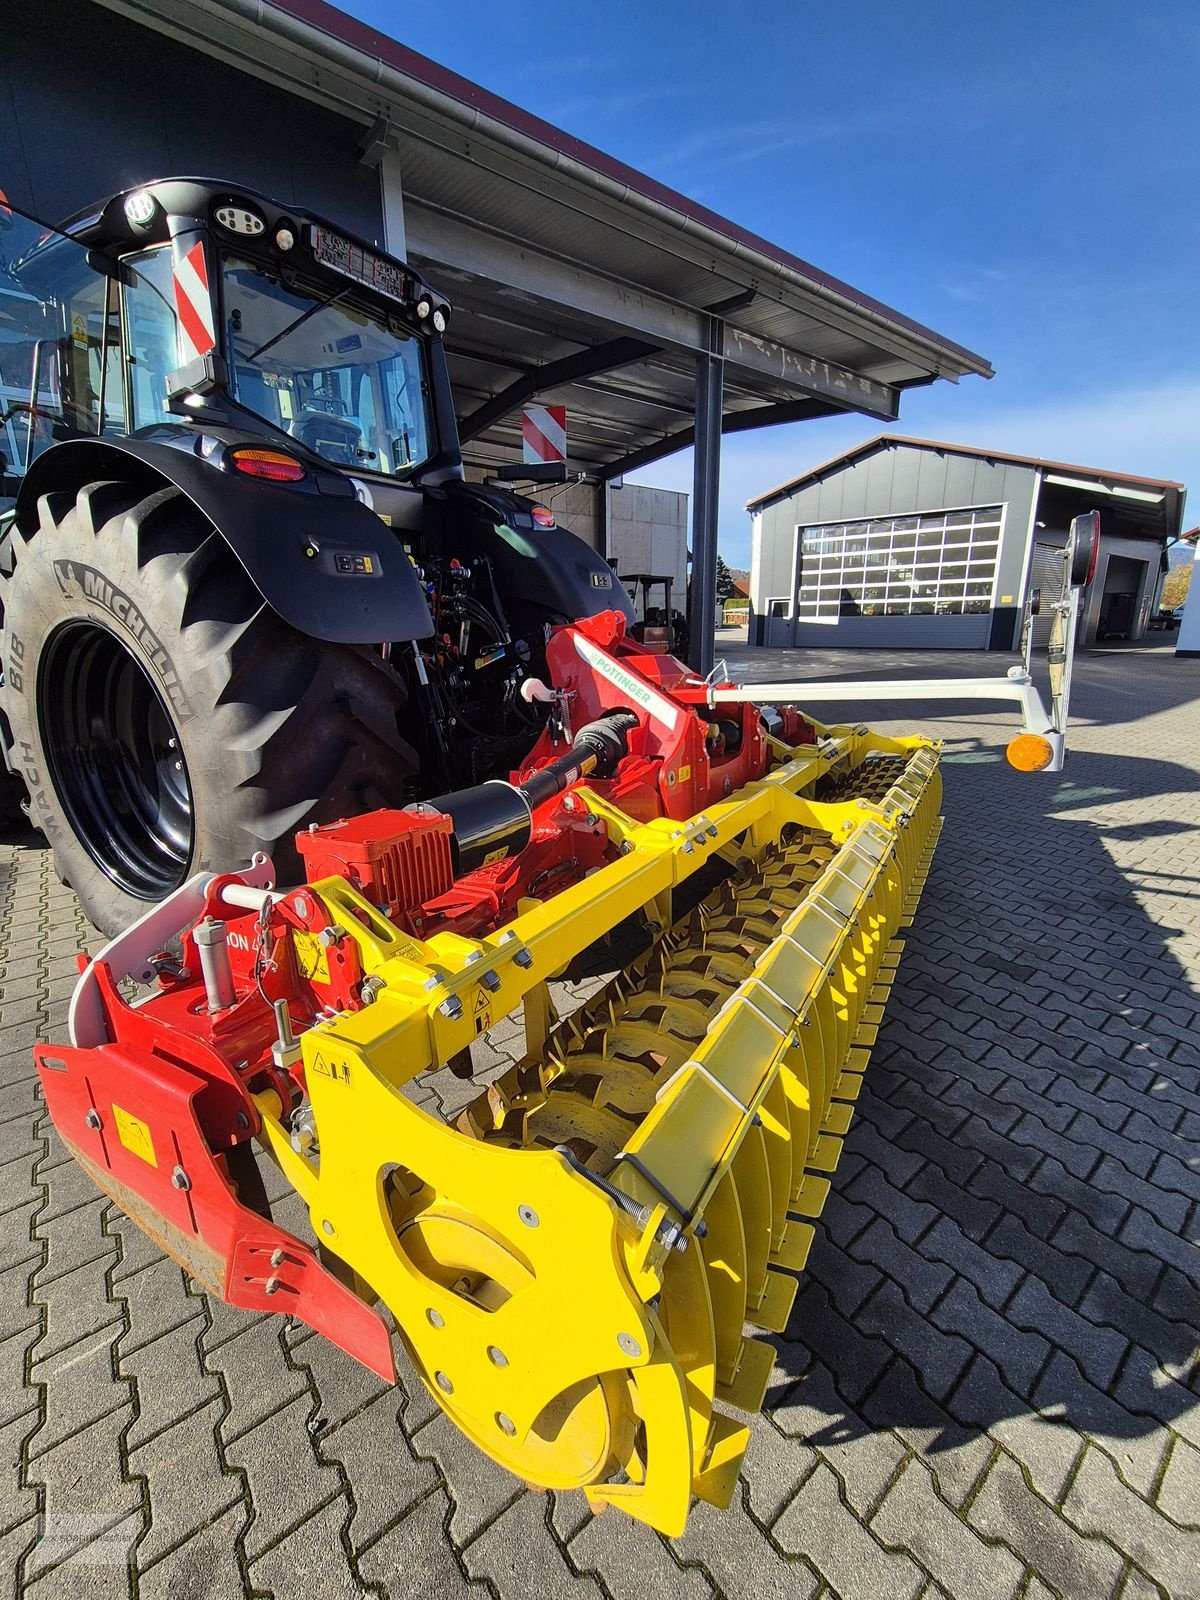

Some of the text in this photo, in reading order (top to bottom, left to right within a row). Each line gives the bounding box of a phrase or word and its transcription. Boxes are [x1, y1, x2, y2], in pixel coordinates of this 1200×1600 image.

[84, 571, 191, 716] MICHELIN
[9, 631, 62, 843] MACH BIB
